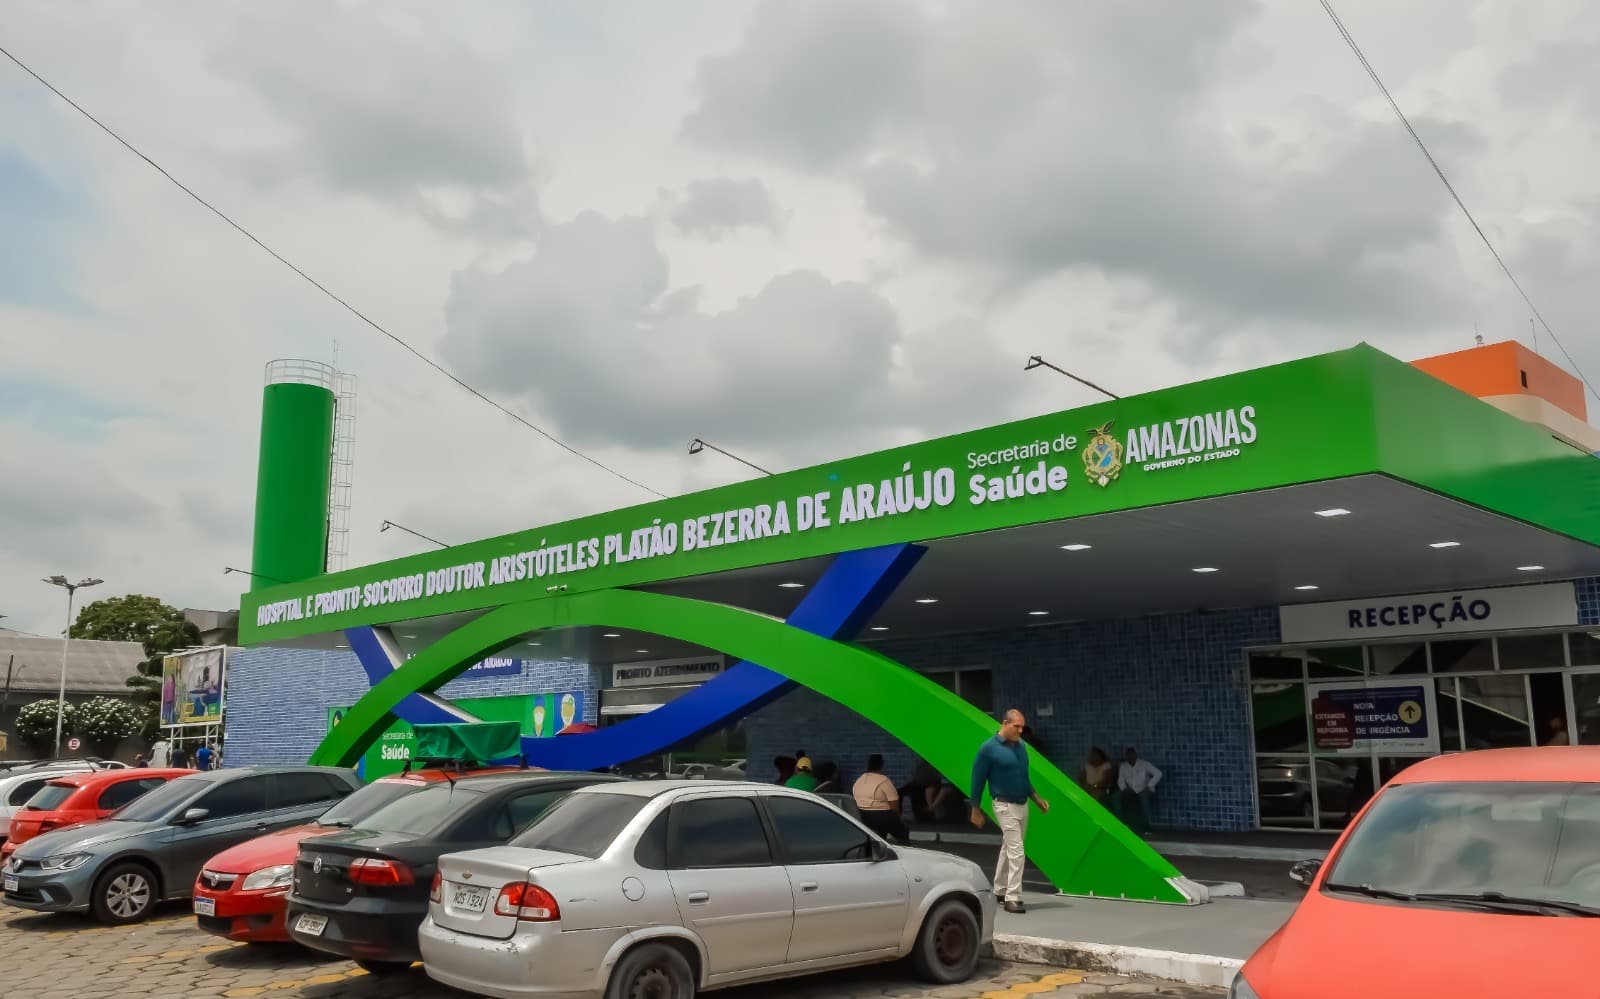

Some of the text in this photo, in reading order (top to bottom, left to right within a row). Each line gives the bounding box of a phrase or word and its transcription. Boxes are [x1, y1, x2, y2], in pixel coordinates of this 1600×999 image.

[967, 433, 1078, 469] Secretaria de
[1125, 405, 1257, 465] AMAZONAS
[1143, 448, 1240, 472] GOVERNO DO ESTADO
[968, 460, 1068, 505] Saúde
[256, 461, 956, 627] HOSPITAL E PRONTO-SOCORRO DOUTOR ARISTÓTELES PLATÃO BEZERRA DE ARAÚJO
[1348, 596, 1492, 629] RECEPÇÃO
[381, 743, 410, 760] Saúde
